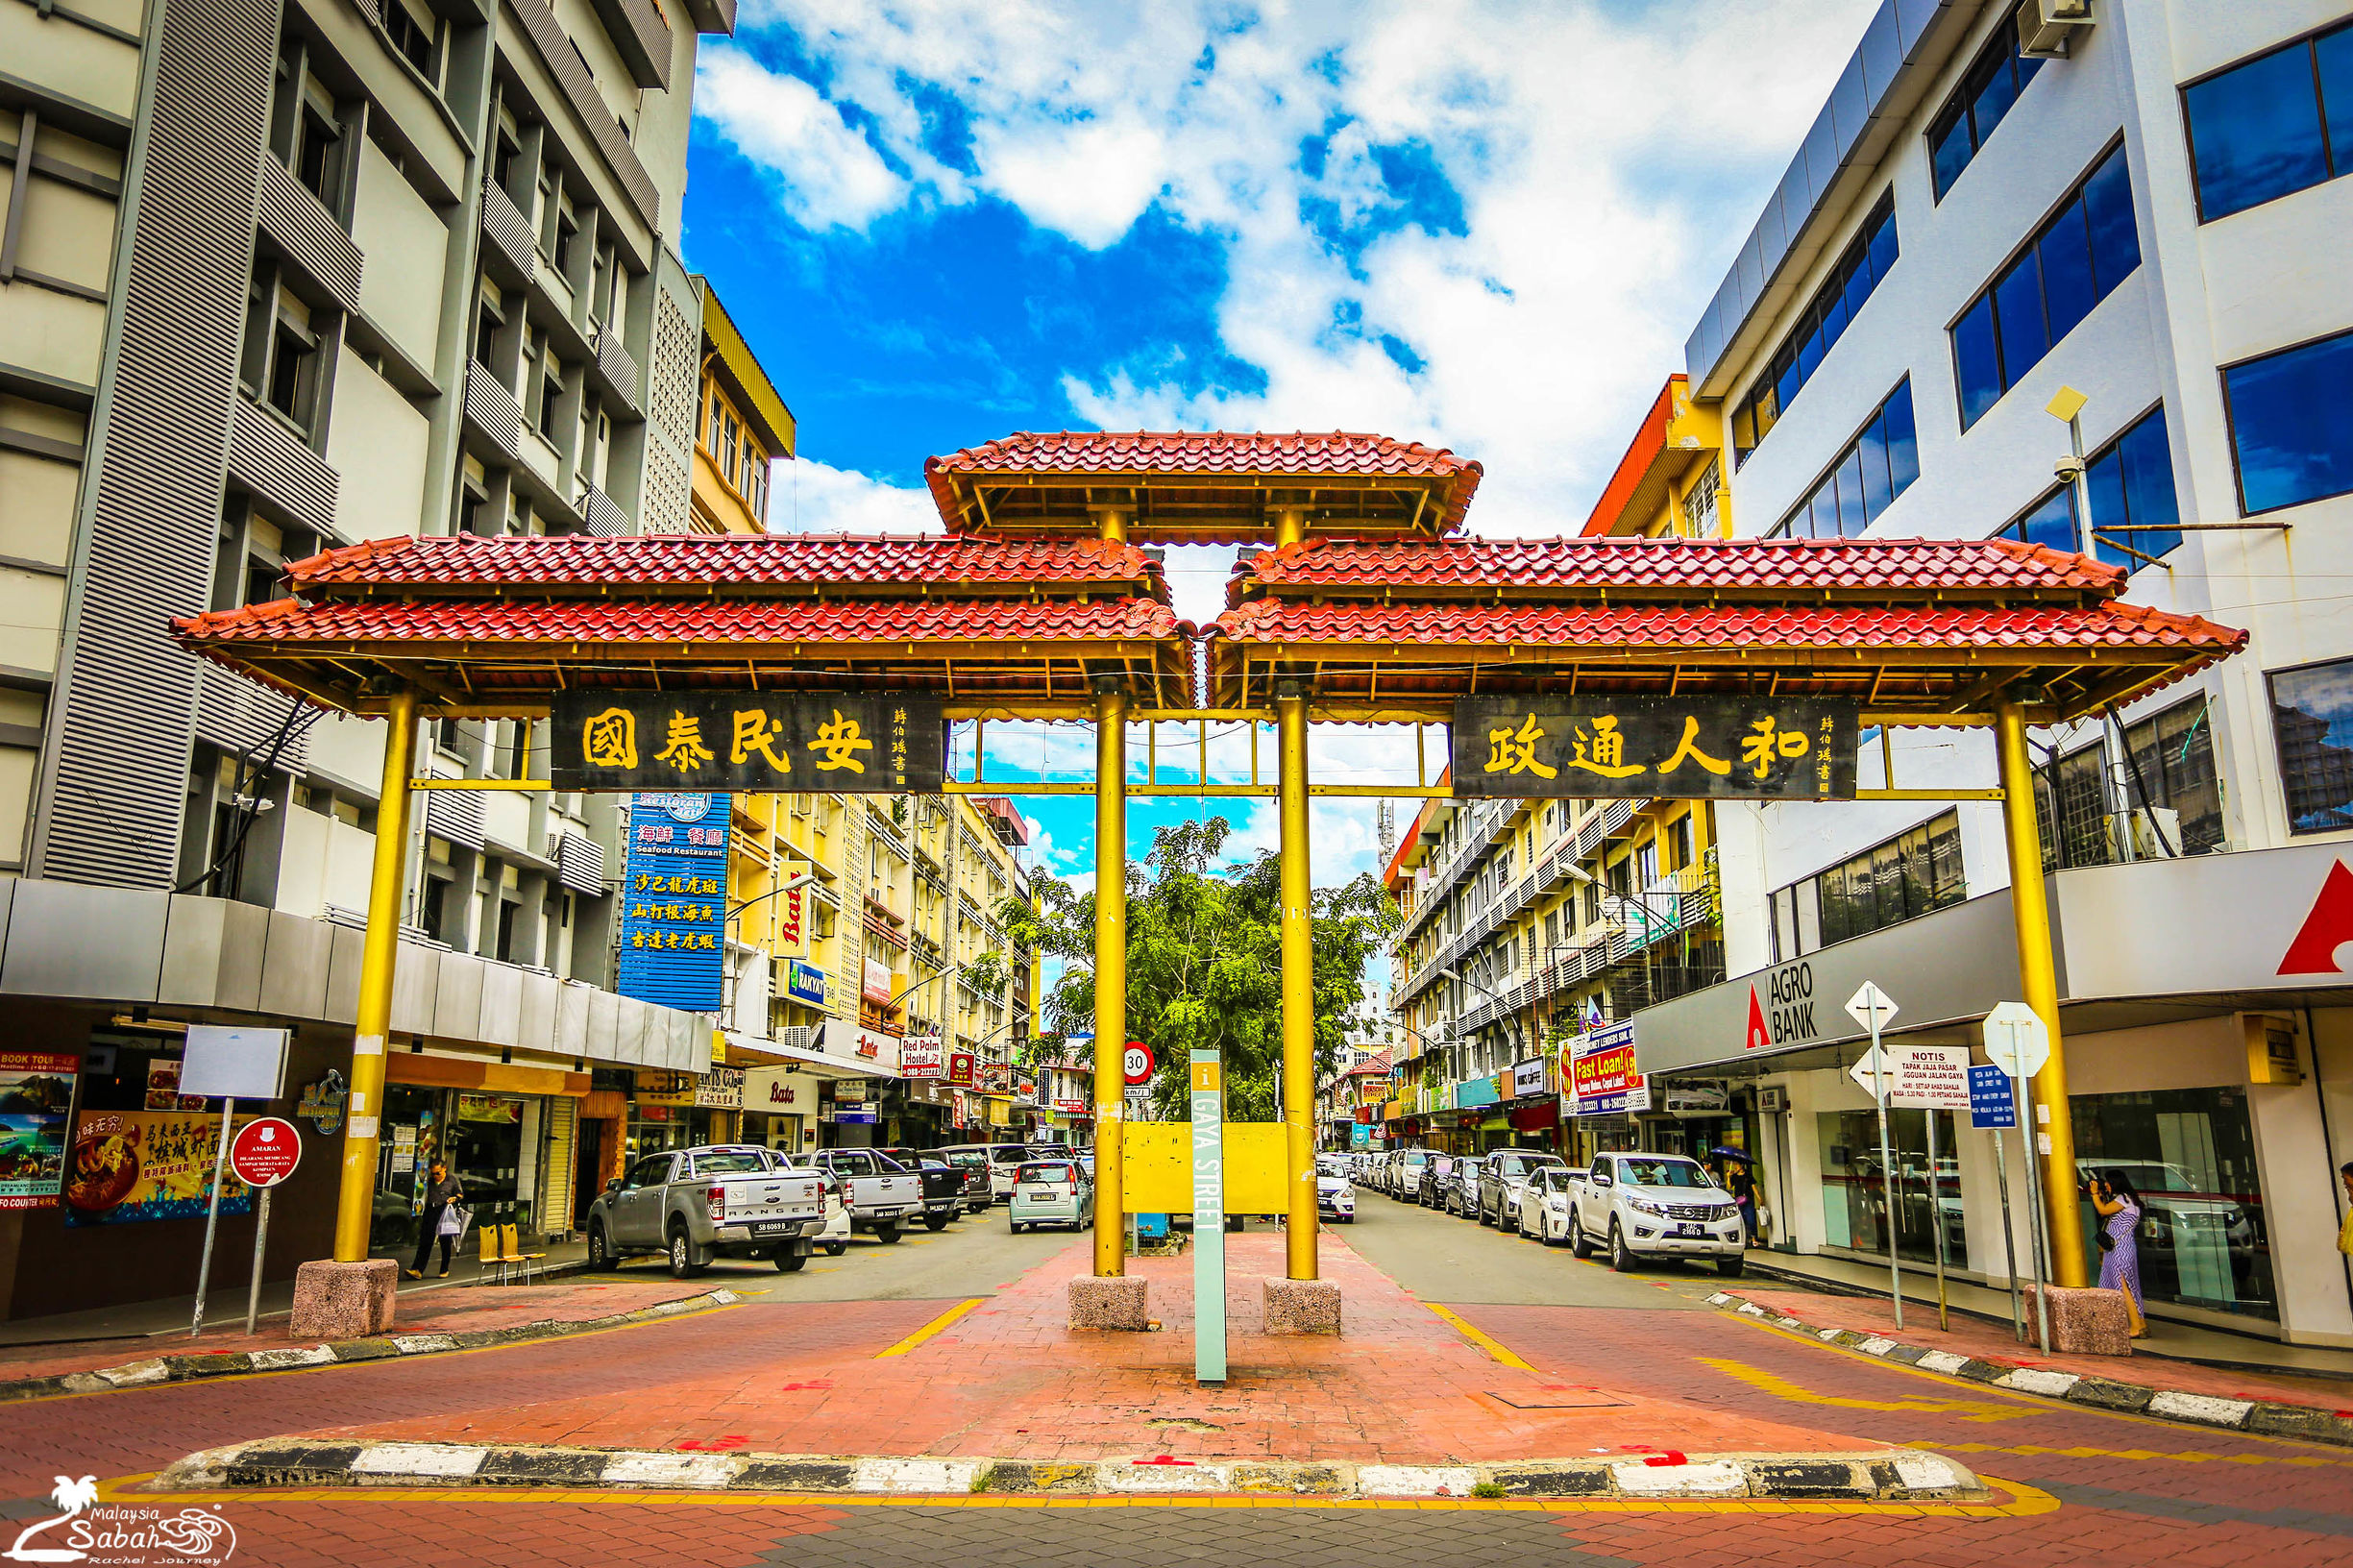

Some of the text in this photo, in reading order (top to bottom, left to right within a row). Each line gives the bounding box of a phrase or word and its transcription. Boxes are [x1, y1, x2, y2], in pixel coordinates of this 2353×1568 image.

[1483, 713, 1810, 779] 政通人和
[636, 845, 723, 857] Seafood Restaurant
[798, 971, 824, 995] RAKYAT
[1771, 961, 1813, 1007] AGRO
[1772, 1001, 1818, 1044] BANK
[903, 1040, 940, 1052] Red Palm
[1, 1054, 29, 1064] BOOK
[905, 1053, 928, 1065] Hostel
[1127, 1056, 1143, 1069] 30
[1912, 1052, 1946, 1062] NOTIS
[1576, 1050, 1625, 1080] Fast Loan!
[770, 1081, 796, 1105] Bata
[1193, 1097, 1221, 1233] GAYA STREET
[728, 1206, 815, 1216] RANGER
[767, 1222, 781, 1231] 6069
